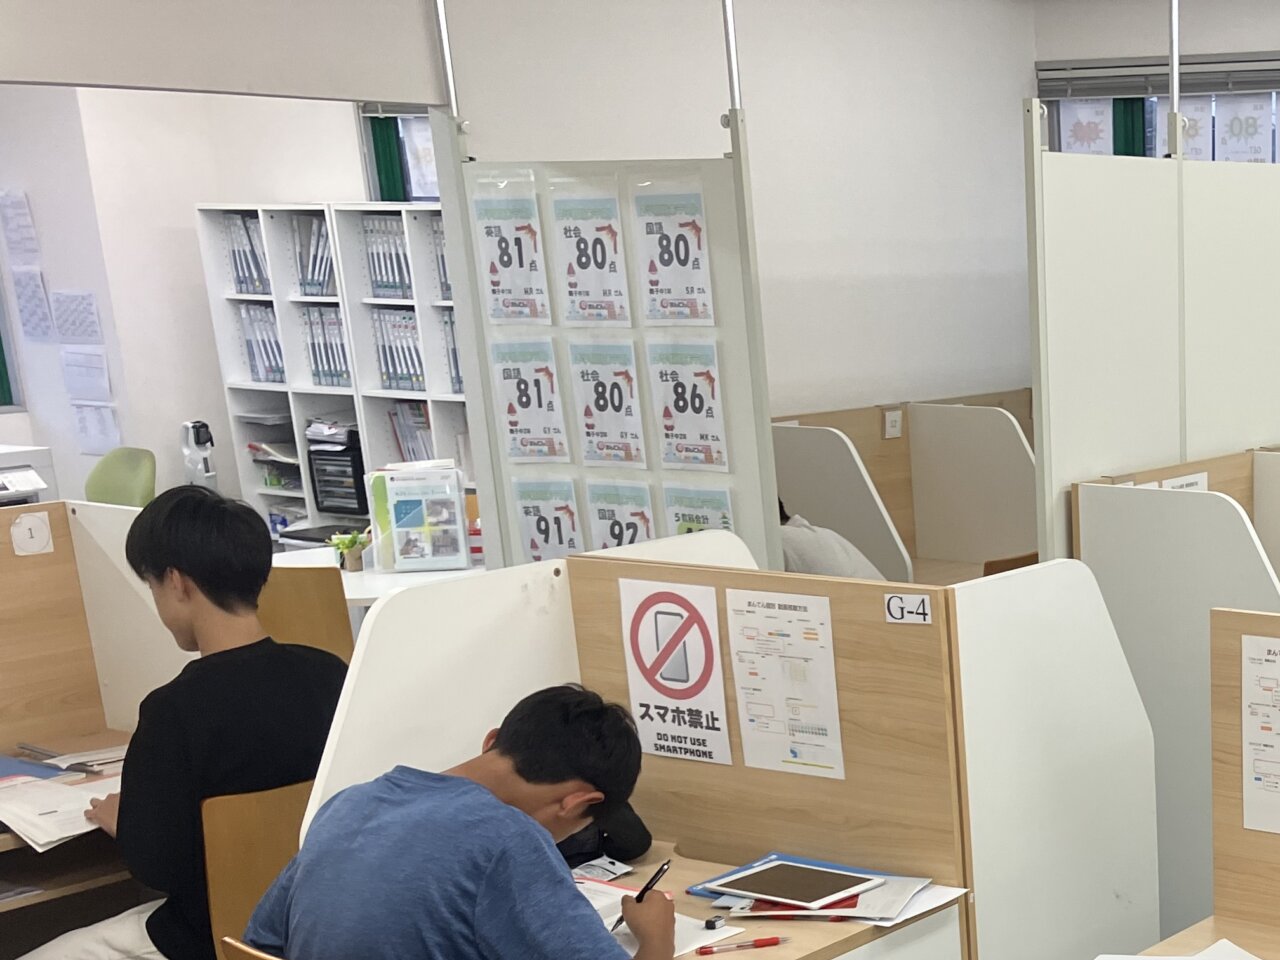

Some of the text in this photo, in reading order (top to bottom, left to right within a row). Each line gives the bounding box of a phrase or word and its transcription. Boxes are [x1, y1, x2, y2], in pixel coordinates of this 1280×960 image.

[886, 595, 929, 622] G-4
[638, 702, 721, 732] スマホ禁止
[656, 732, 707, 748] DO NOT USE
[653, 743, 714, 760] SMARTPHONE
